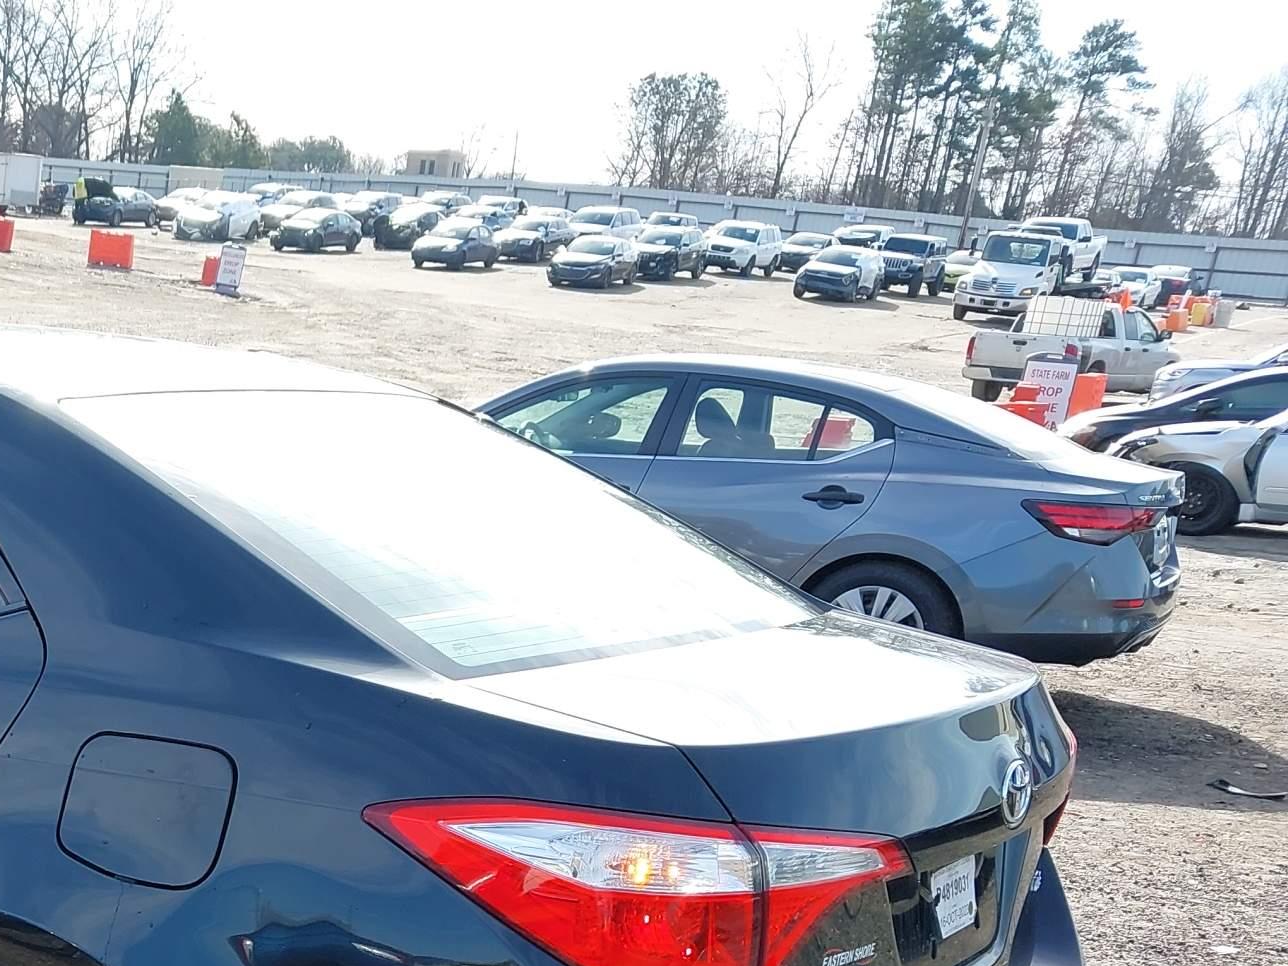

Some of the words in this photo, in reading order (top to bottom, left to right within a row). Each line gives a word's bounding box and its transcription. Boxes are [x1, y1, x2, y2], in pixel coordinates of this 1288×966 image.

[1031, 368, 1051, 380] STATE
[1052, 370, 1071, 381] FARM
[1039, 386, 1063, 397] ROP
[854, 943, 876, 961] SHORE
